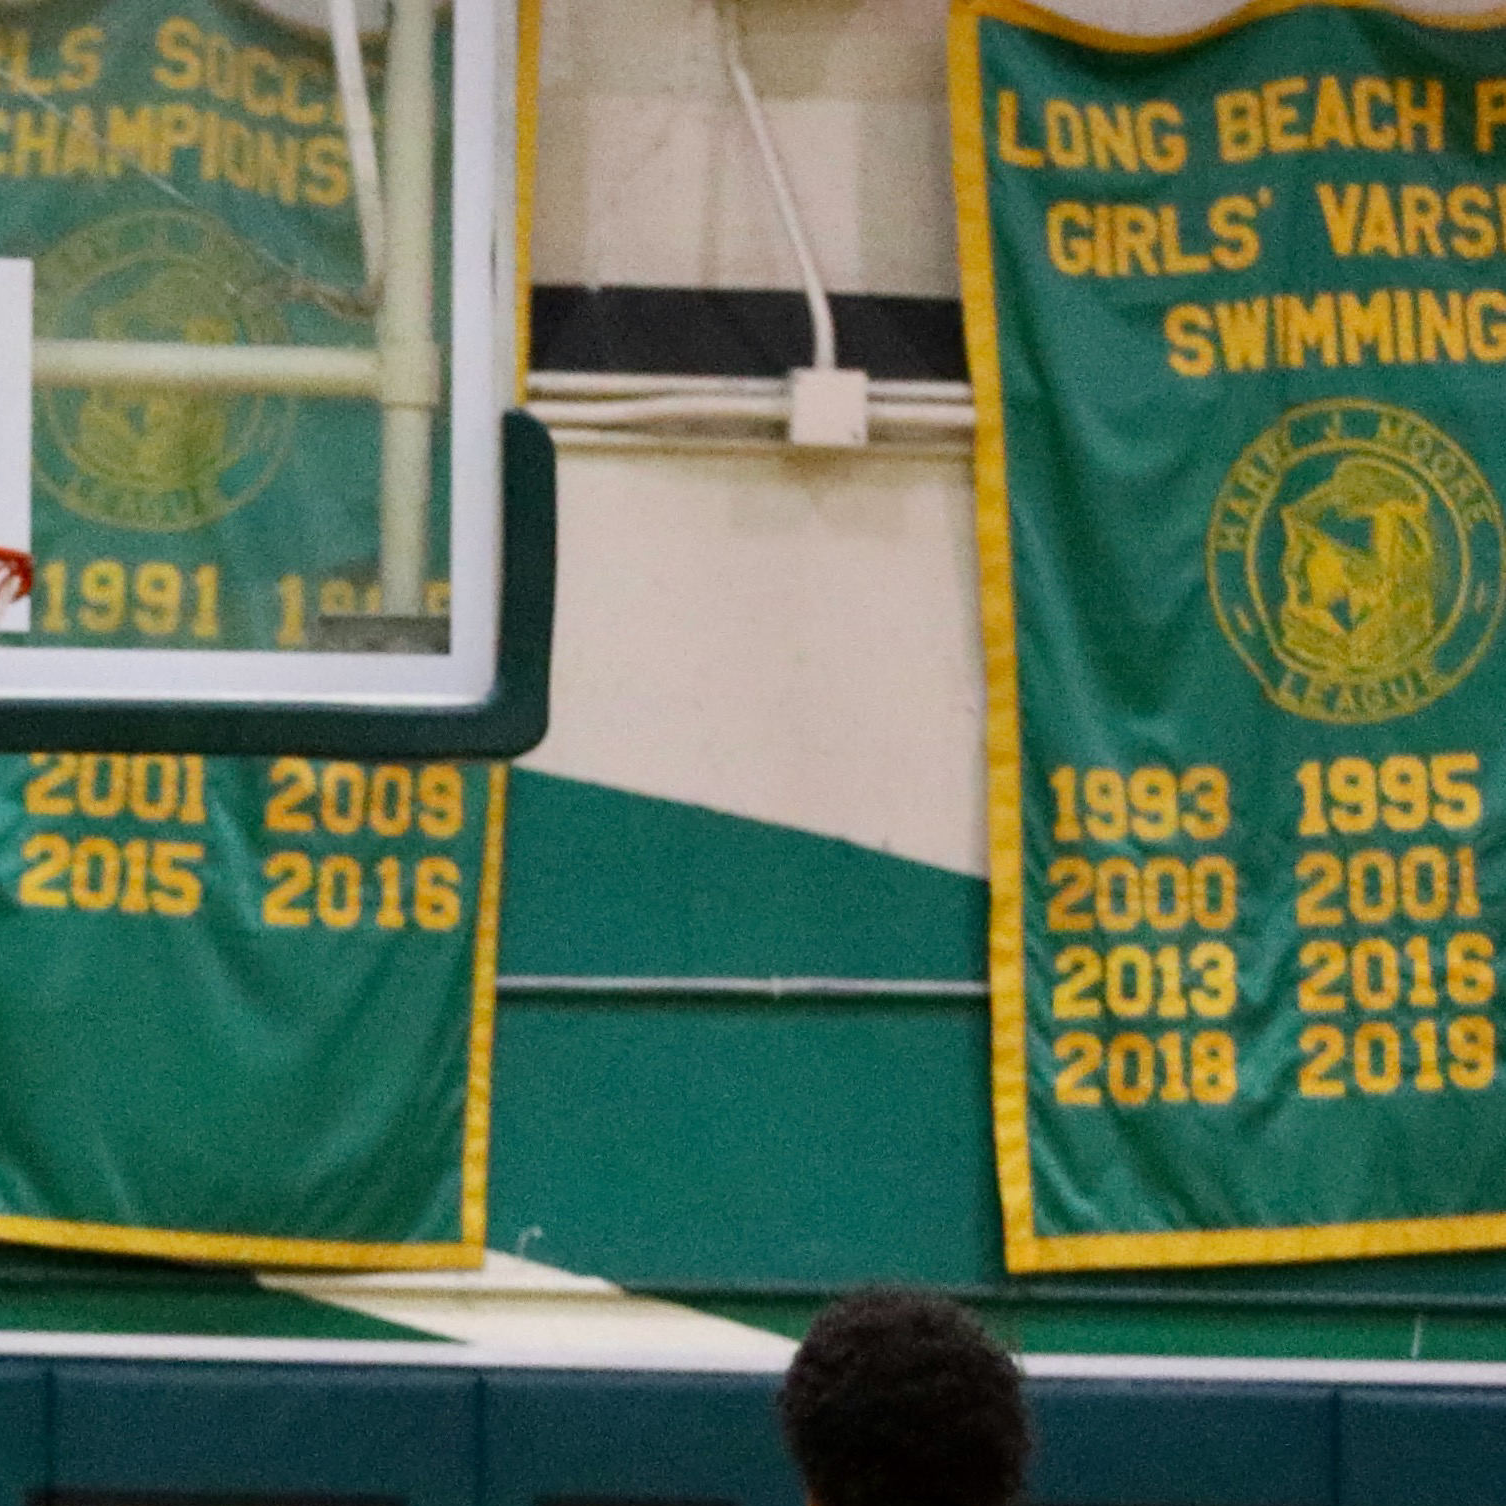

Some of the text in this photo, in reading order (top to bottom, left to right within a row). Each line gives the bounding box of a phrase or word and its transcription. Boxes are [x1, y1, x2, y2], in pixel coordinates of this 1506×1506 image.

[999, 91, 1187, 173] LONG
[1216, 76, 1443, 162] BEACH
[1047, 187, 1271, 278] GIRLS'
[1164, 289, 1506, 376] SWIMMING
[43, 561, 219, 638] 1991
[26, 754, 206, 823] 2001
[266, 757, 464, 839] 2009
[1050, 752, 1482, 841] 1993 1995
[18, 833, 204, 916] 2015
[262, 851, 462, 931] 2016
[1047, 845, 1481, 932] 2000 2001
[1053, 931, 1496, 1019] 2013 2016
[1053, 1015, 1496, 1106] 2018 2019
